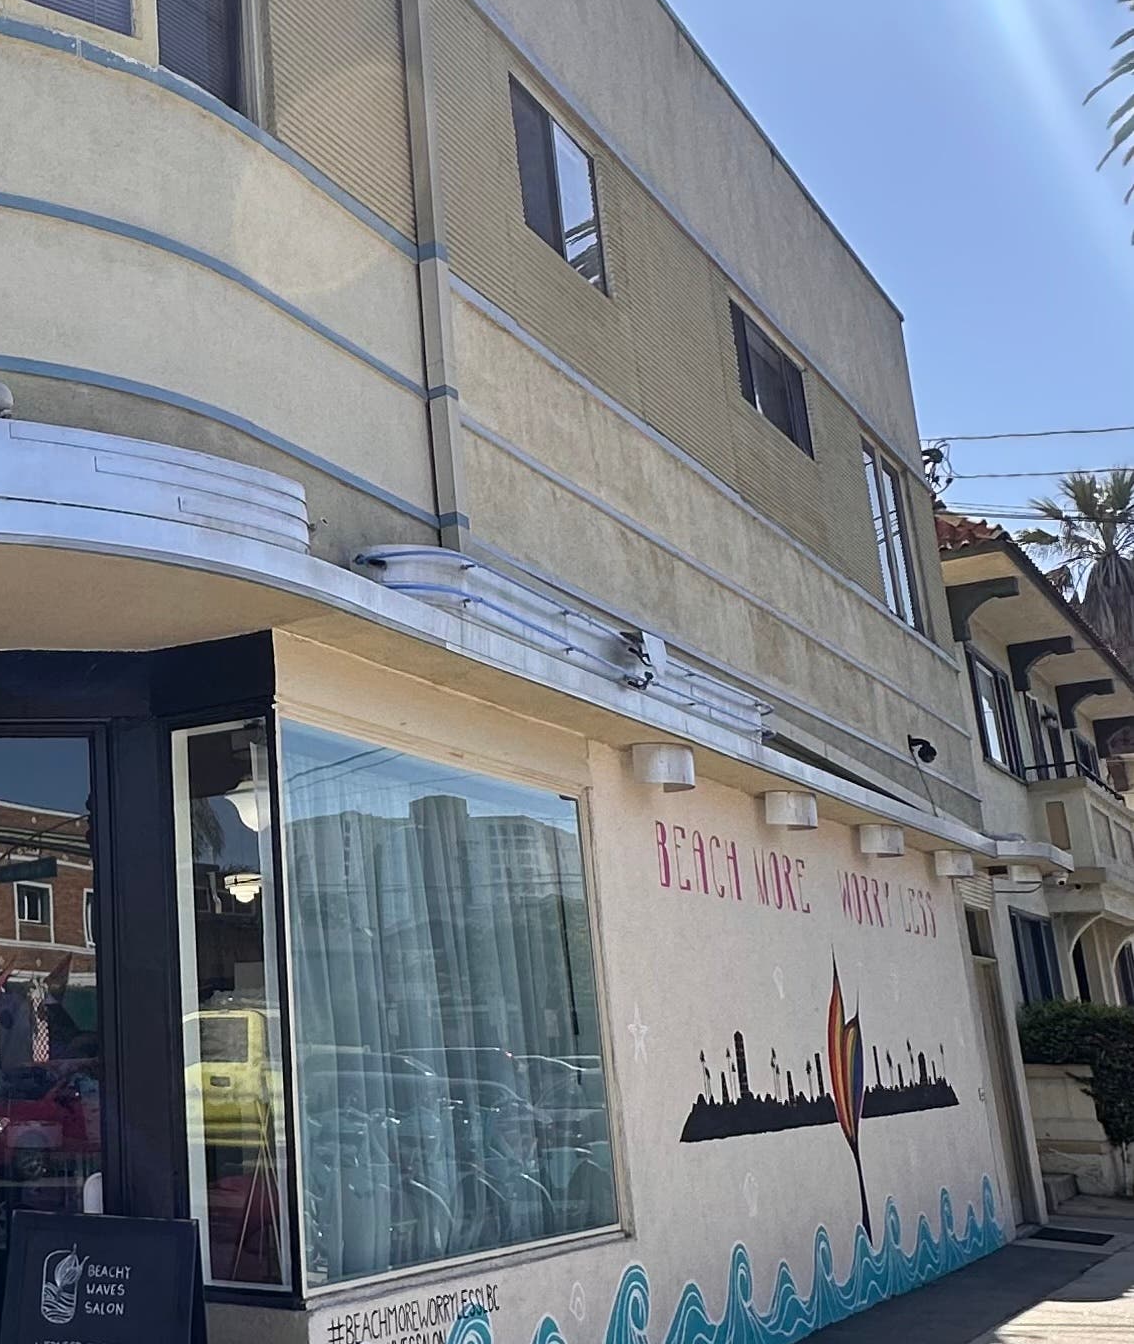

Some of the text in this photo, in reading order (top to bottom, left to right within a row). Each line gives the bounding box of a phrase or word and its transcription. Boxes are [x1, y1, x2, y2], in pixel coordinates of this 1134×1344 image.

[655, 820, 937, 938] BEACH MORE WORRY LESS
[88, 1264, 131, 1279] BEACHY
[86, 1284, 125, 1296] WAVES
[85, 1301, 124, 1315] SALON
